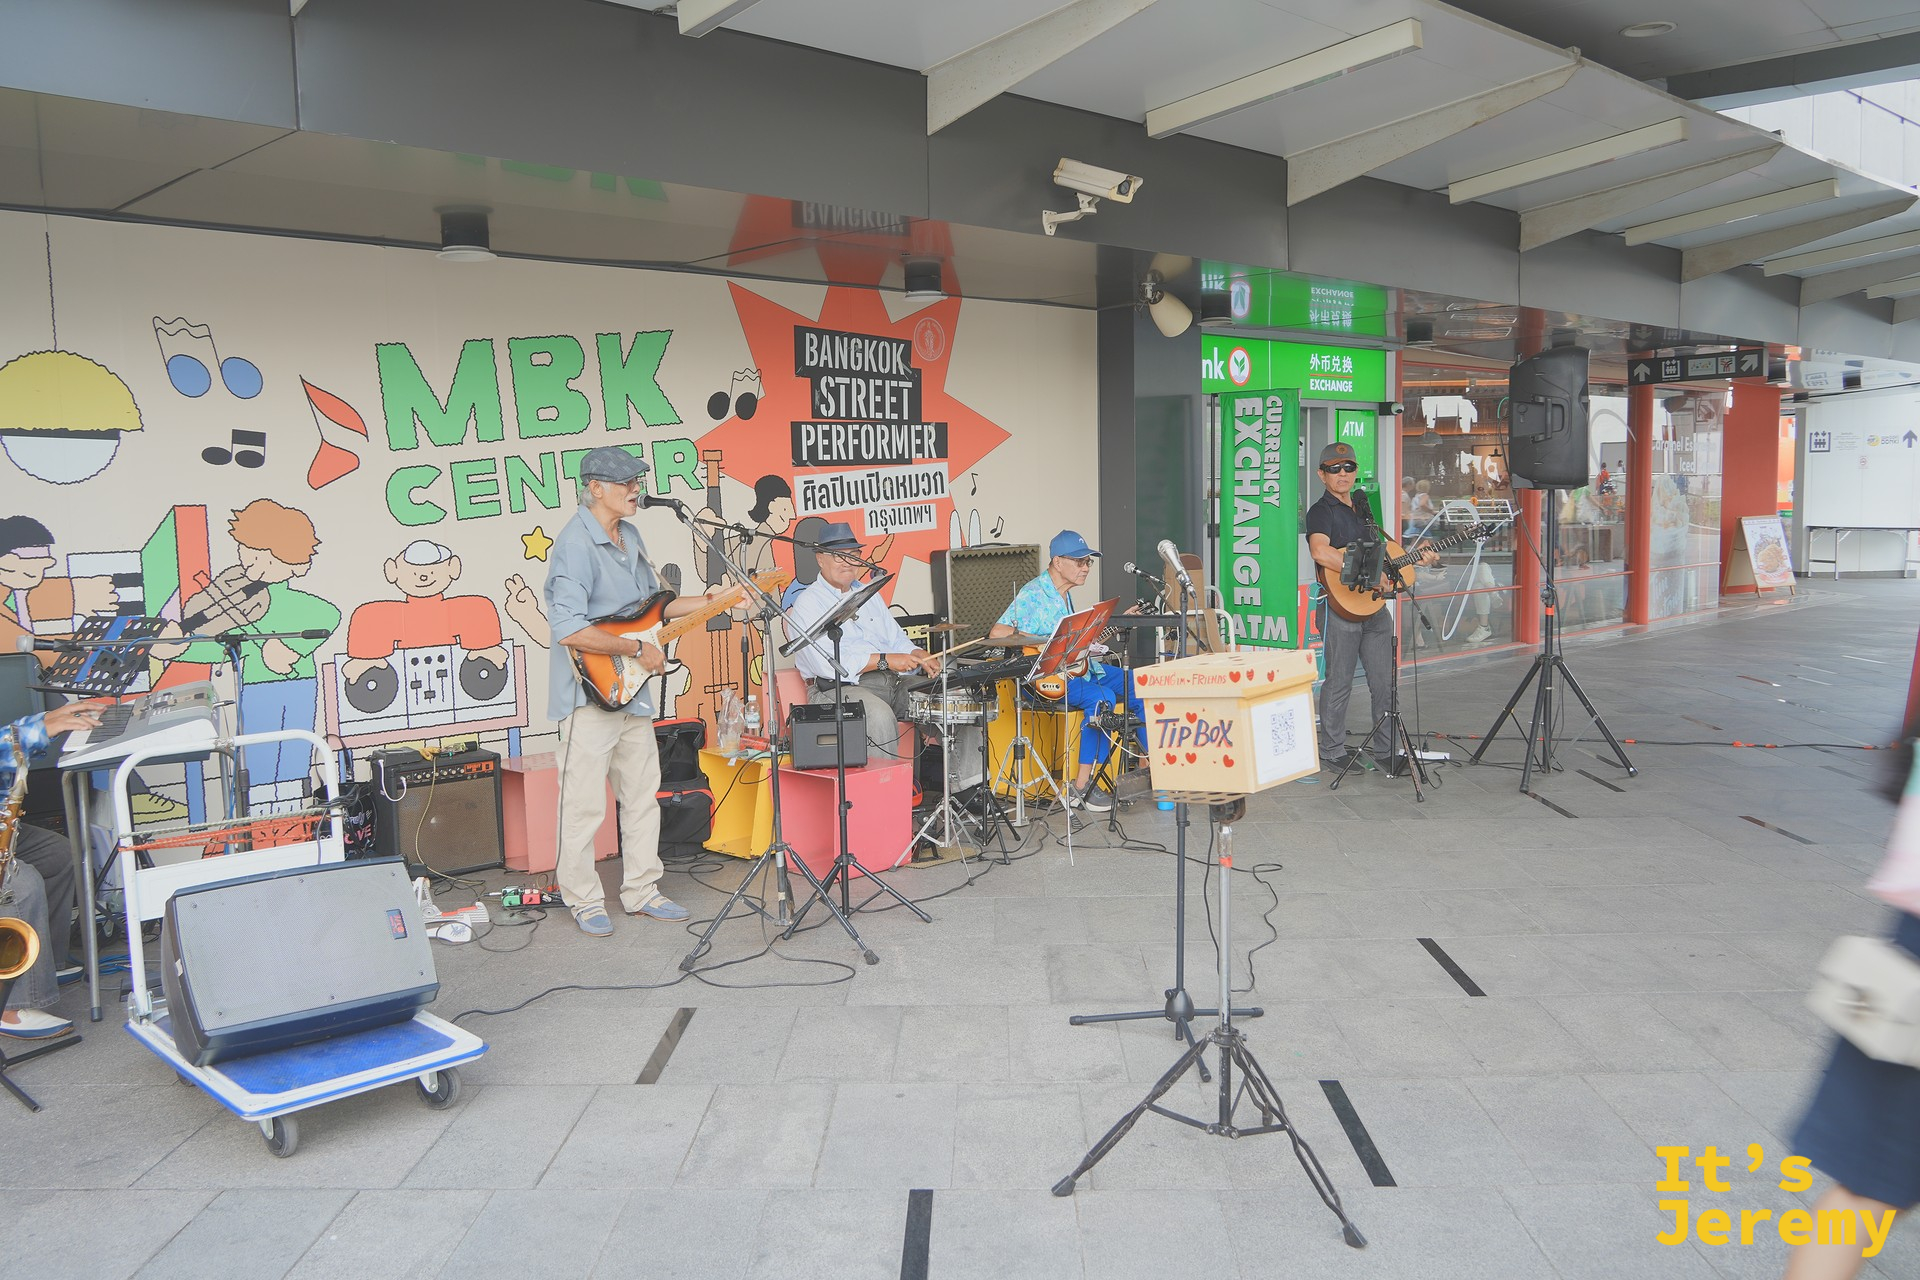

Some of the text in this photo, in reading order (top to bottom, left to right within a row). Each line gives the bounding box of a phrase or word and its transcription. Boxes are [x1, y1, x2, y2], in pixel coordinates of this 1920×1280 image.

[805, 332, 906, 375] BANGKOK
[1309, 353, 1353, 374] 外币兑换
[374, 329, 684, 452] MBK
[820, 375, 913, 420] STREET
[1309, 378, 1353, 393] EXCHANGE
[800, 424, 937, 461] PERFORMER
[1342, 421, 1364, 437] ATM
[1263, 395, 1283, 508] CURRENCY
[385, 437, 705, 527] CENTR
[803, 470, 945, 511] ศิลปินเปิดหมวก
[1232, 397, 1264, 607] EXCHANGE
[868, 505, 932, 534] กรุงเทพฯ
[1229, 613, 1289, 642] ATM
